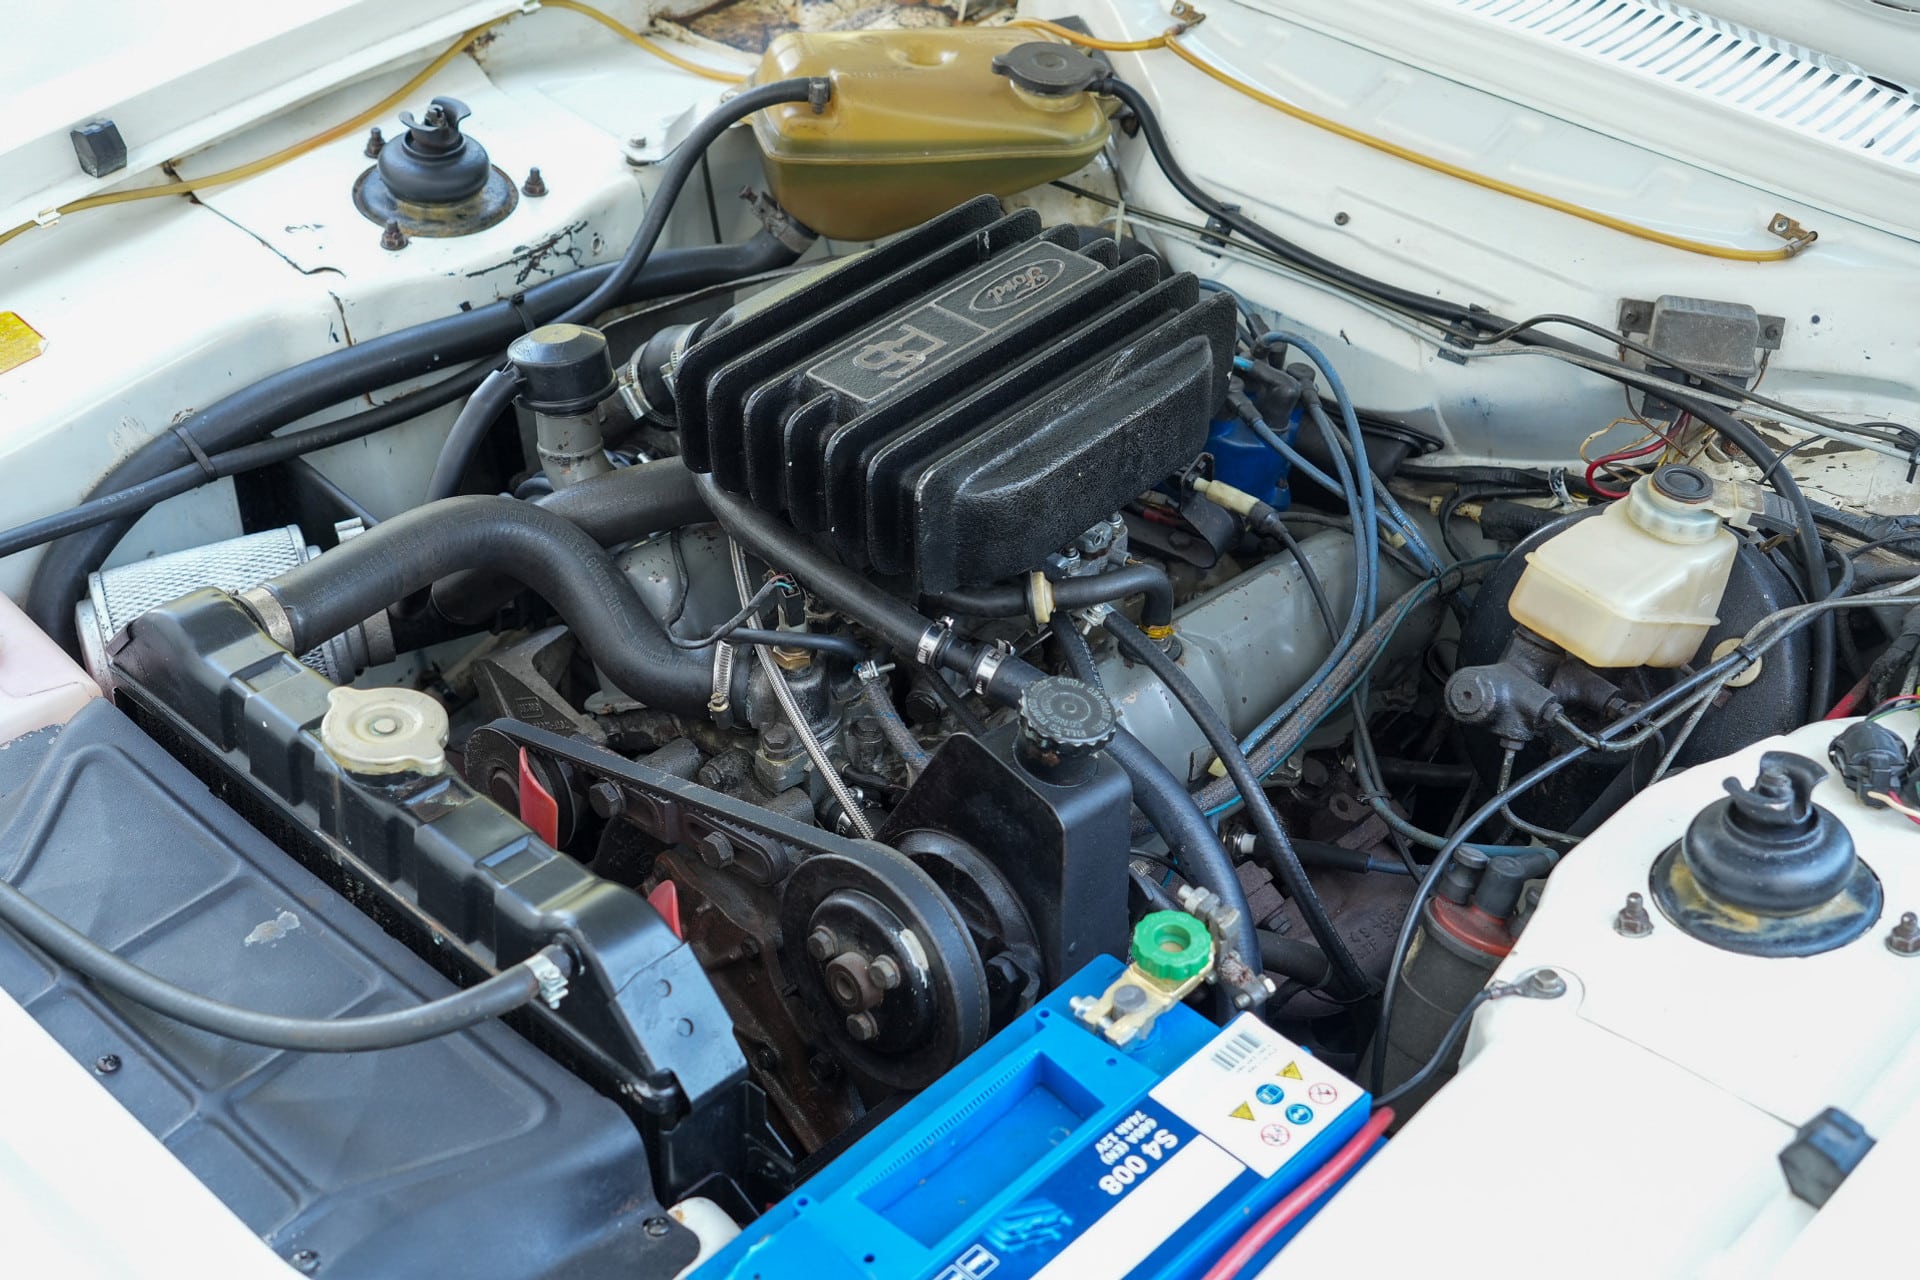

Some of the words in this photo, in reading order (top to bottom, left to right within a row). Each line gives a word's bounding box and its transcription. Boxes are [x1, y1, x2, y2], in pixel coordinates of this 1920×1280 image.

[985, 266, 1049, 305] Ford
[1057, 677, 1086, 689] FLUID
[1063, 728, 1087, 738] FILL
[1095, 1132, 1120, 1154] 12V
[1140, 1128, 1179, 1161] S4
[1098, 1154, 1148, 1196] 008
